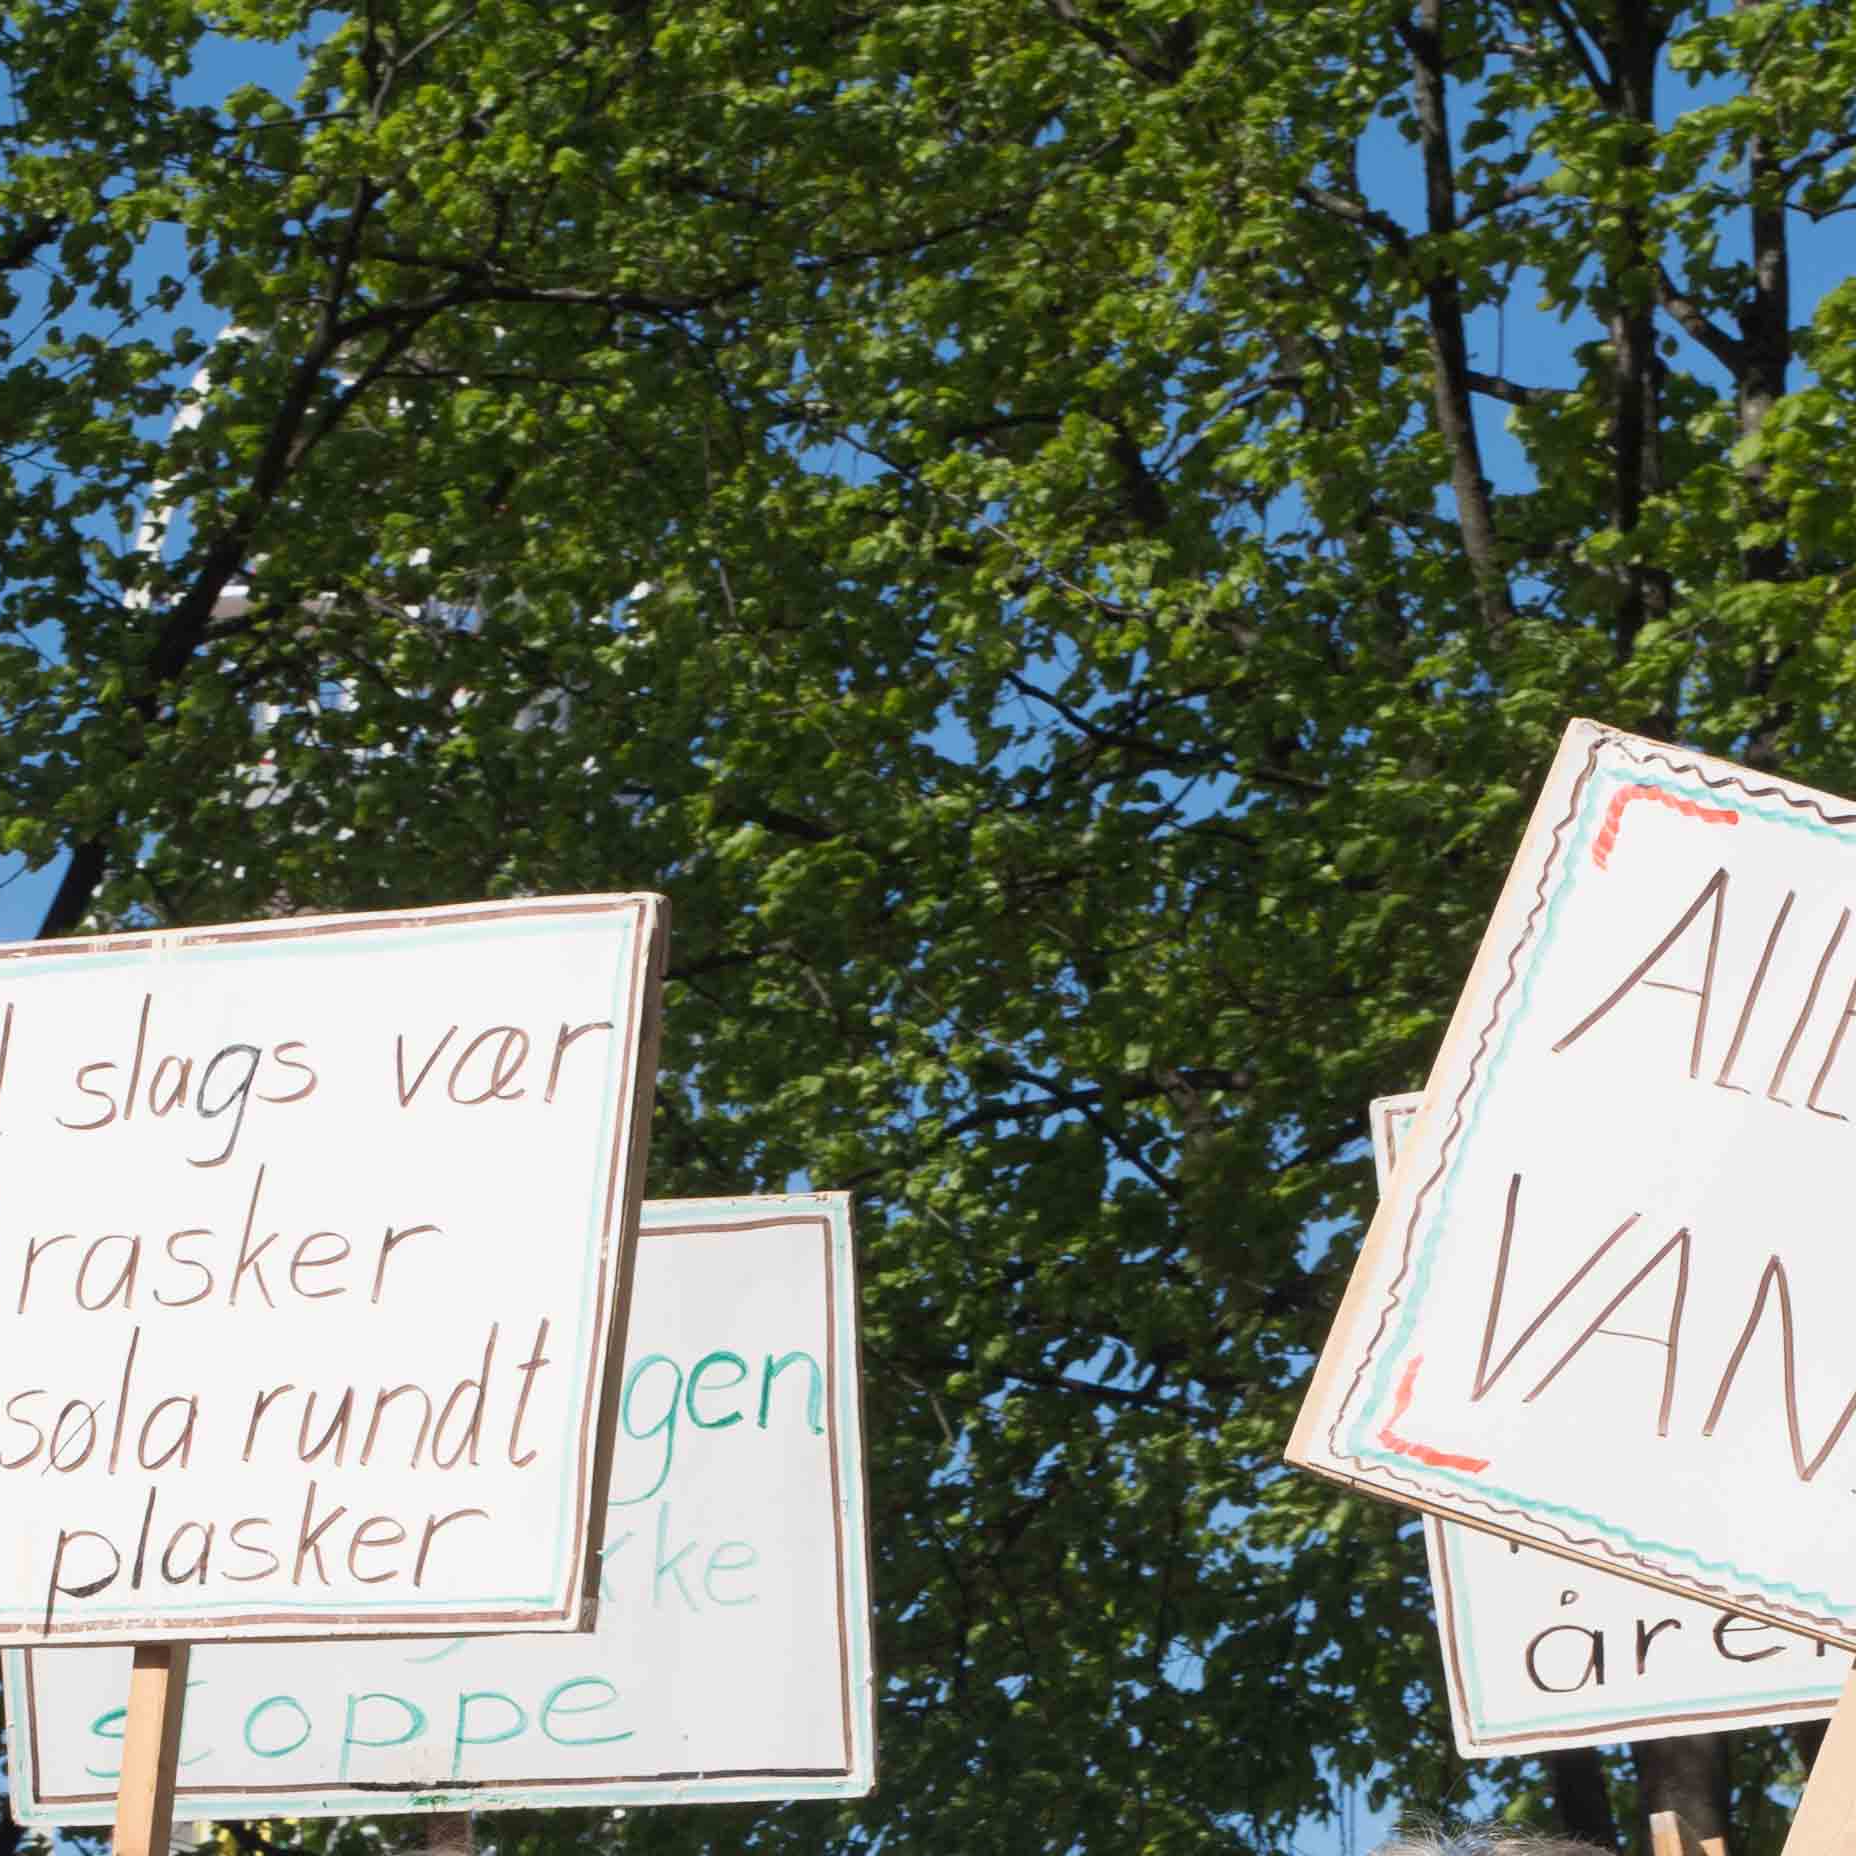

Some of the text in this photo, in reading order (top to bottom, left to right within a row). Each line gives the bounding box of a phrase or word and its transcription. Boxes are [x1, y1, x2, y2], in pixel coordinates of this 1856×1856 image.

[55, 993, 319, 1168] slags
[396, 1019, 614, 1108] vær
[240, 1319, 551, 1469] rundt
[607, 1350, 826, 1506] gen
[43, 1480, 491, 1638] plasker
[84, 1675, 634, 1778] soppe
